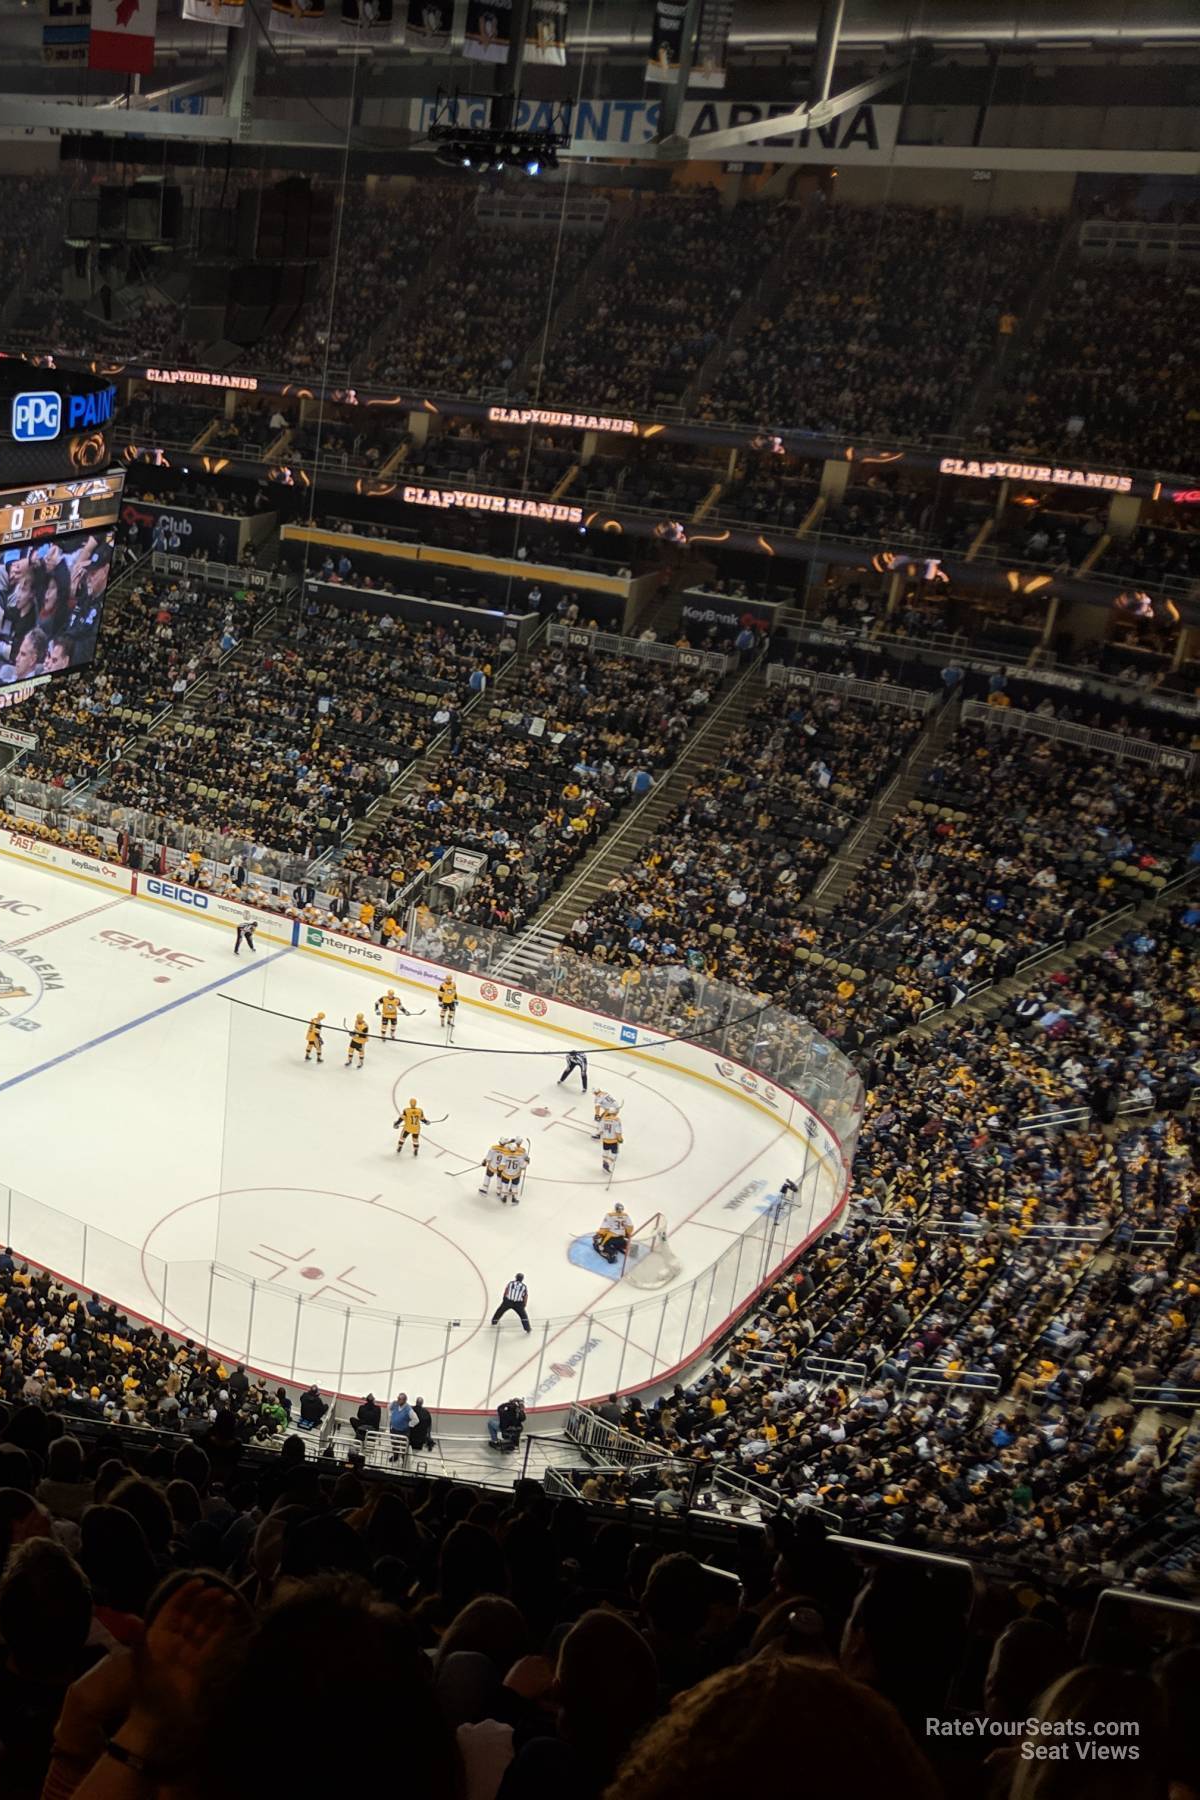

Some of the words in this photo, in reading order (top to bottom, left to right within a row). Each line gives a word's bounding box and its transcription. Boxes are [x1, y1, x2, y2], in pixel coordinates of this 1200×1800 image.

[689, 102, 879, 150] ARENA
[211, 374, 257, 390] HANDS
[16, 398, 58, 435] PPG
[573, 415, 634, 433] HANDS
[1052, 469, 1133, 491] HANDS
[11, 508, 25, 531] 0
[40, 505, 59, 521] 8:32
[69, 498, 81, 521] 1
[506, 498, 583, 523] HANDS
[158, 516, 192, 535] Club
[170, 561, 183, 571] 101
[251, 575, 264, 586] 101
[682, 606, 739, 625] KeyBank
[570, 633, 589, 646] 103
[680, 653, 699, 666] 103
[789, 674, 810, 686] 104
[0, 730, 30, 744] GNC
[1160, 753, 1186, 769] 104
[71, 858, 100, 873] KeyBank
[146, 879, 209, 909] GEICO
[217, 904, 243, 916] VECTOR
[89, 934, 129, 951] LIVE
[138, 952, 186, 971] WELL
[98, 929, 205, 969] GNC
[311, 930, 383, 962] enterprise
[7, 947, 65, 991] ARENA
[506, 989, 522, 1005] IC
[506, 1159, 519, 1170] 76
